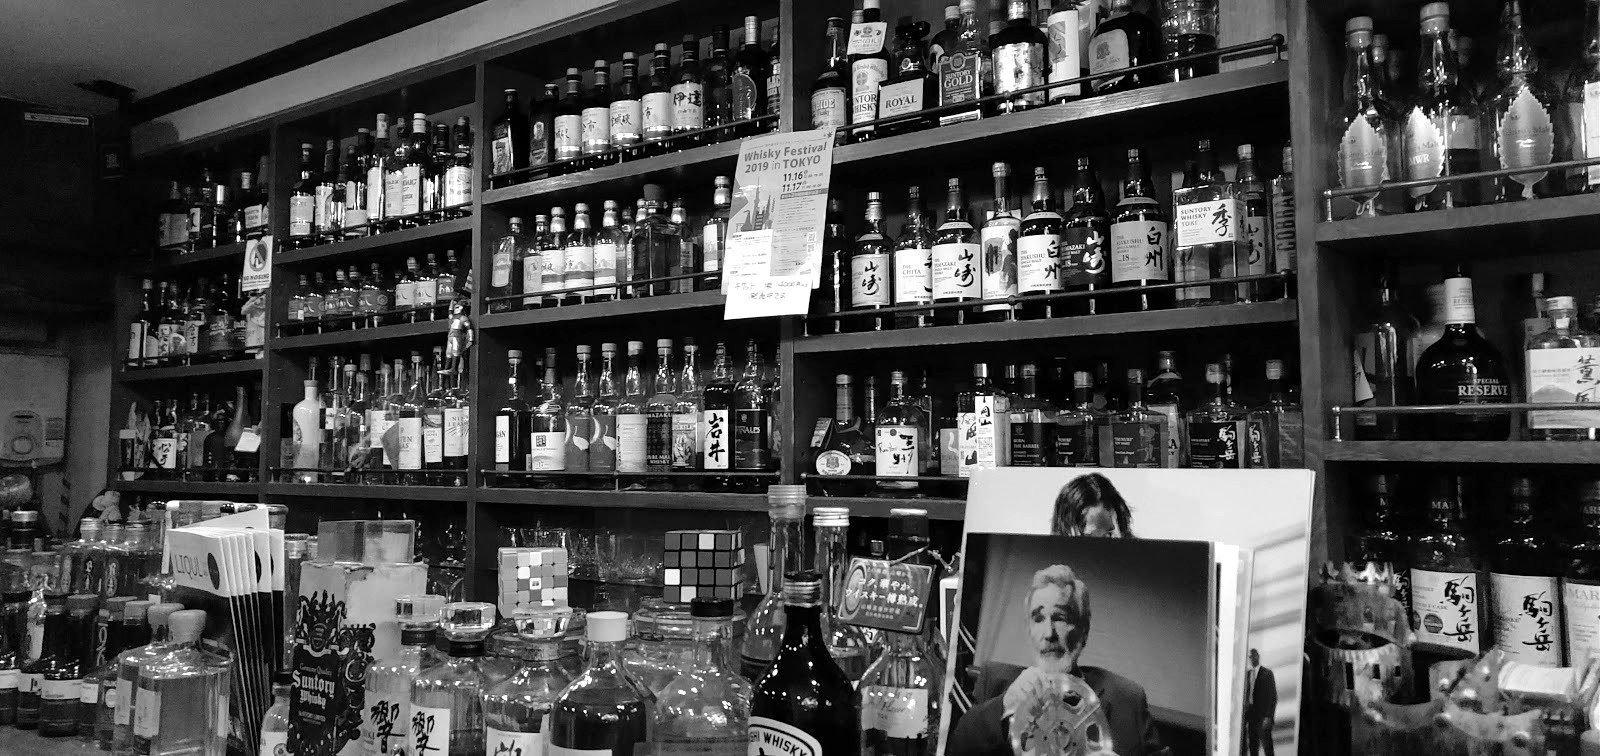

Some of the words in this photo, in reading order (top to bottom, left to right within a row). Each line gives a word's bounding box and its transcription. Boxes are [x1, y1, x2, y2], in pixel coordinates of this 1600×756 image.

[944, 75, 973, 88] GOLD
[946, 70, 971, 80] SUNTORY
[886, 95, 918, 109] ROYAL
[744, 149, 781, 162] Whisky
[784, 141, 828, 156] Festival
[745, 163, 768, 173] 2019
[772, 161, 781, 170] in
[783, 155, 821, 169] TOKYO
[783, 171, 803, 182] 11.16
[782, 181, 802, 192] 11.17
[1180, 206, 1211, 216] SUNTORY
[1180, 213, 1206, 222] WHISKY
[1180, 220, 1197, 228] TOKI
[1211, 203, 1232, 237] 季
[1145, 226, 1161, 271] 白州
[1045, 239, 1061, 280] 白州
[1122, 253, 1130, 262] 18
[954, 248, 977, 288] 山崎
[861, 260, 882, 296] 山崎
[1474, 377, 1499, 385] SPECIAL
[1457, 384, 1509, 396] RESERVE
[706, 412, 725, 463] 岩井
[292, 668, 335, 700] Suntory
[763, 731, 808, 756] WHISKY
